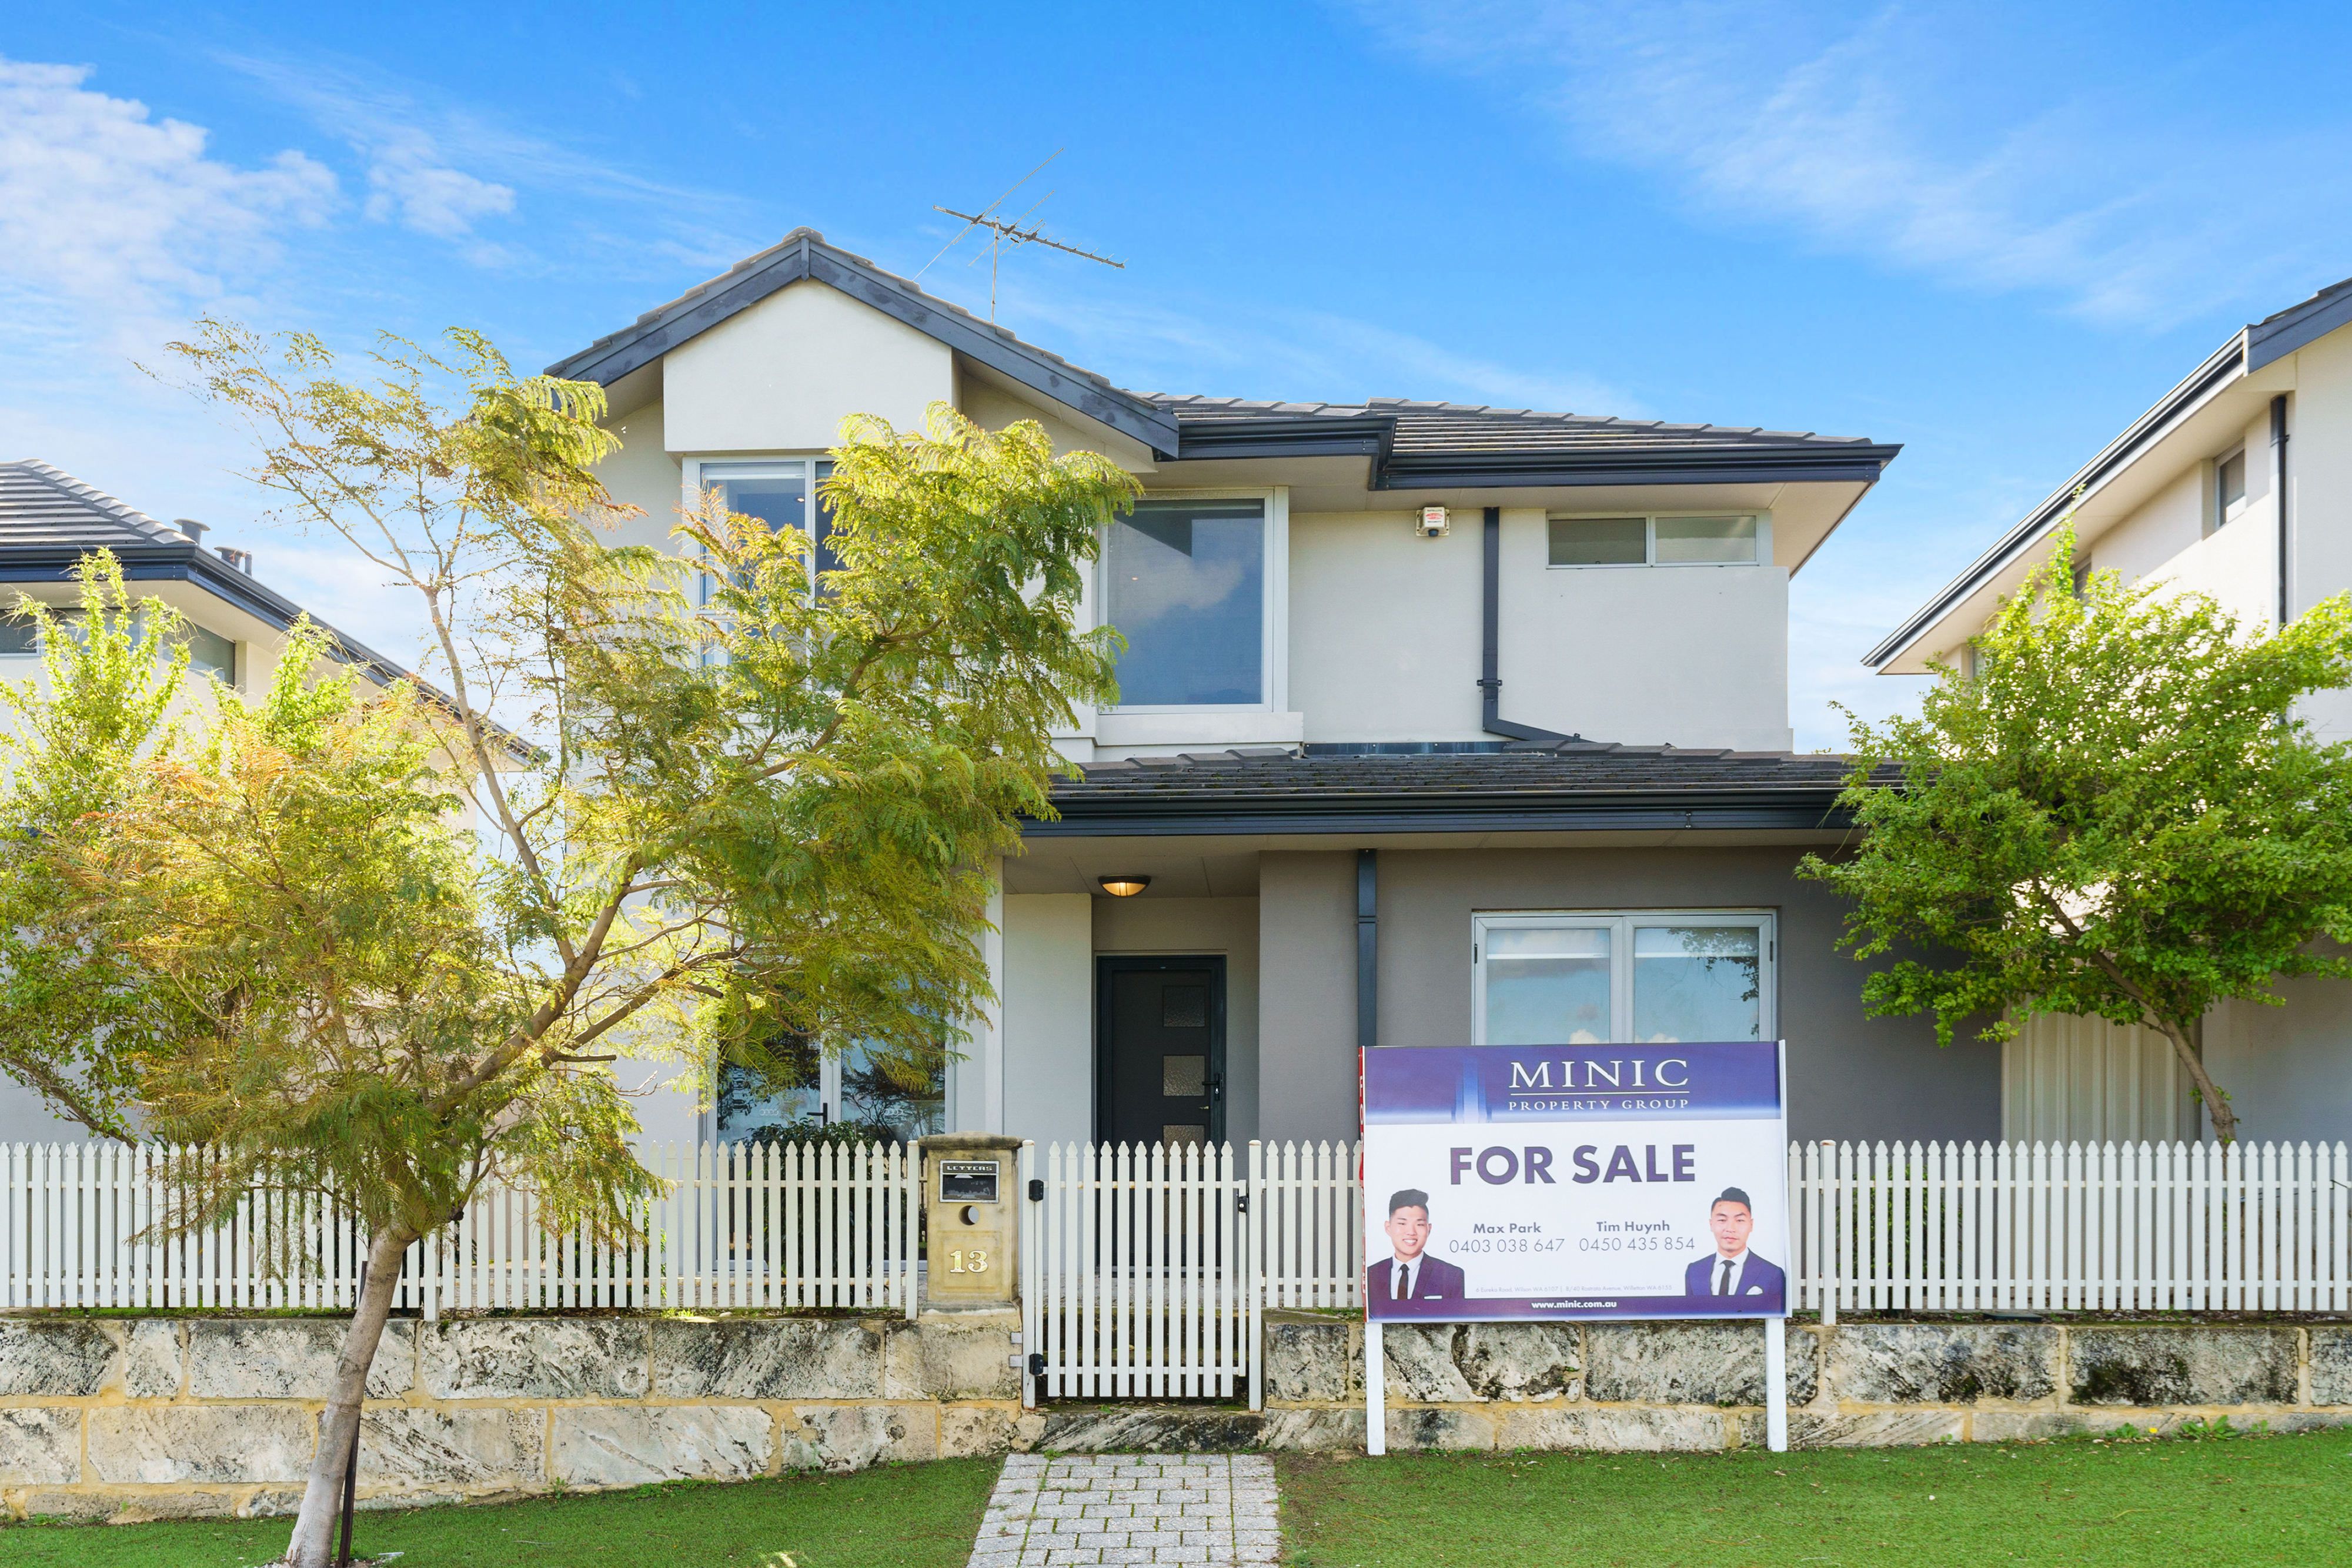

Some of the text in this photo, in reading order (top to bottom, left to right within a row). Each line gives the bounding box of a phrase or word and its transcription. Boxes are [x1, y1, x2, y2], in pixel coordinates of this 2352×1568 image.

[1509, 1059, 1688, 1088] MINIC
[1509, 1099, 1688, 1111] PROPERTY GROUP
[1450, 1144, 1695, 1185] FOR SALE
[1473, 1222, 1542, 1233] Max Park
[1596, 1220, 1670, 1234] Tim Huynh
[1449, 1238, 1565, 1253] 0403 038 647
[1579, 1237, 1695, 1251] 0450 435 854
[950, 1250, 988, 1273] 13
[1531, 1300, 1617, 1309] www.minic.com.au
